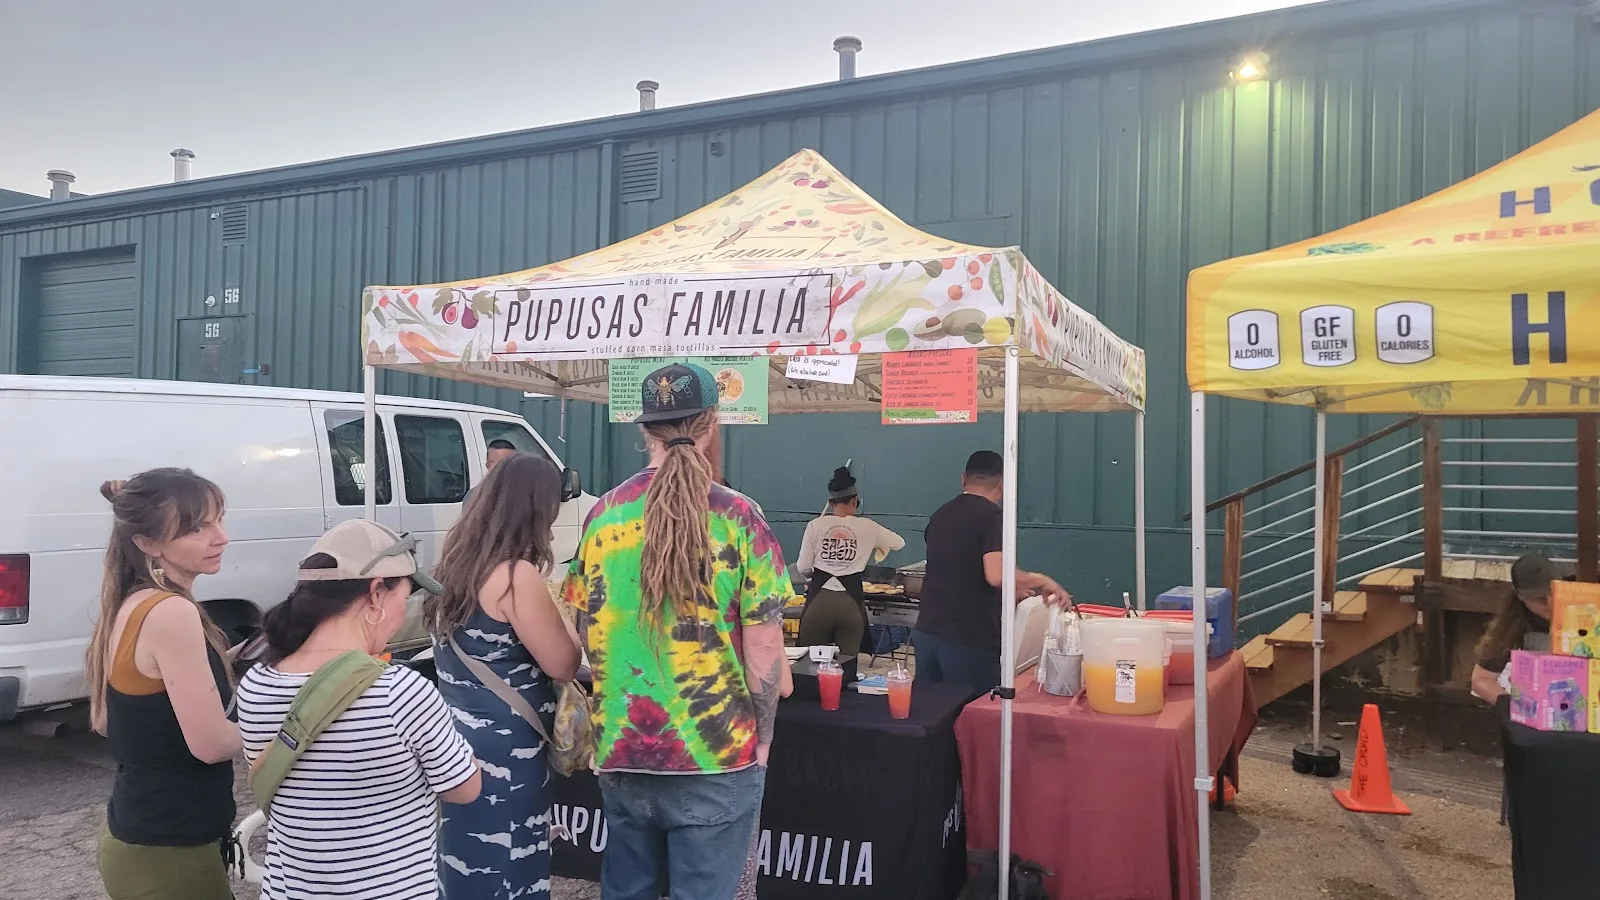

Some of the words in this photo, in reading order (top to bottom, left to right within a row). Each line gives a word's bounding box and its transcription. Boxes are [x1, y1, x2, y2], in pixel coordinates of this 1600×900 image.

[629, 276, 679, 286] hand-made
[503, 293, 649, 343] PUPUSAS
[665, 287, 809, 337] FAMILIA
[1314, 316, 1341, 337] GF
[1397, 314, 1411, 337] 0
[1247, 322, 1259, 346] 0
[591, 343, 623, 354] stuffed
[627, 345, 647, 353] corn
[650, 344, 672, 352] masa
[676, 342, 716, 352] tortillas
[1311, 339, 1348, 350] GLUTEN
[1380, 340, 1429, 351] CALORIES
[1234, 348, 1275, 360] ALCOHOL
[1318, 351, 1343, 362] FREE
[821, 538, 858, 550] SALTY
[820, 548, 857, 561] CREW
[550, 803, 609, 853] UPU
[757, 829, 873, 886] AMILIA
